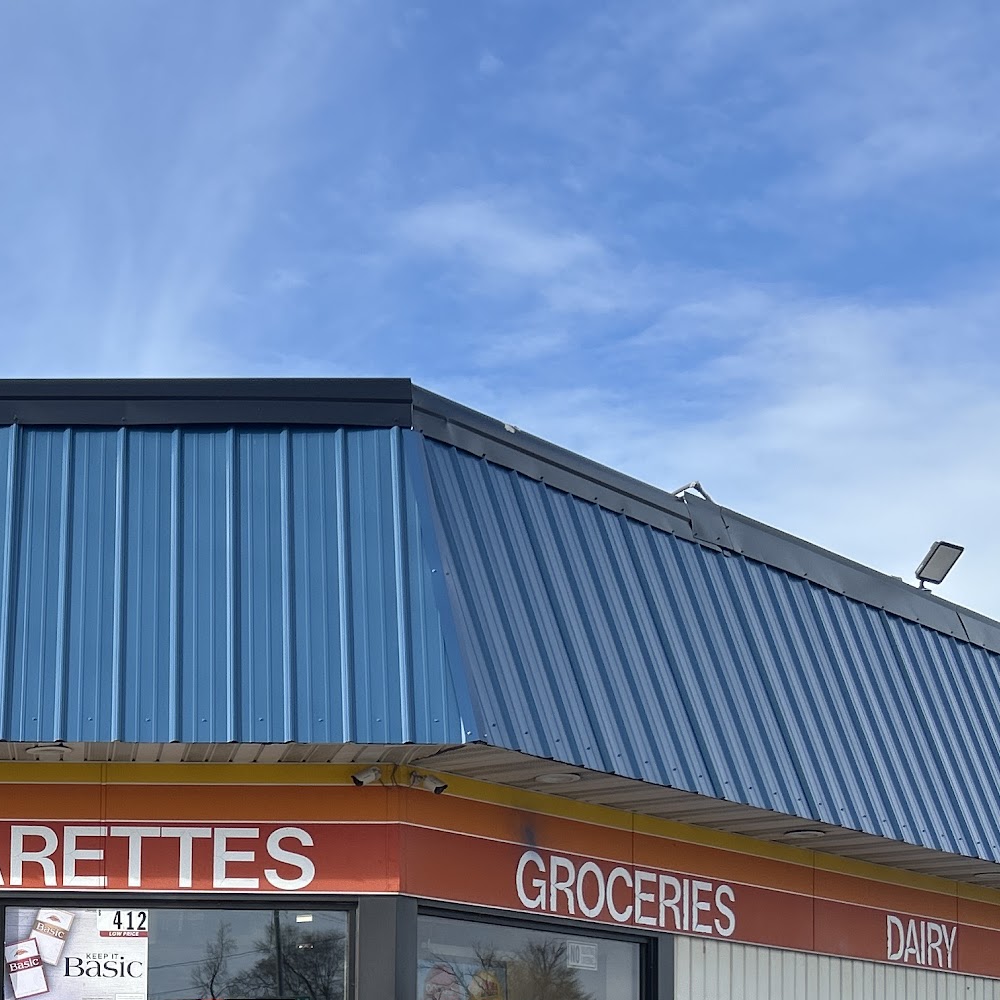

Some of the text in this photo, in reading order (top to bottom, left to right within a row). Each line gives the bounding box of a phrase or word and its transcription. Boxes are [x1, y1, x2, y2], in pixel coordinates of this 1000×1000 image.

[515, 850, 736, 937] GROCERIES
[36, 922, 65, 938] Basic
[886, 915, 957, 969] DAIRY
[570, 945, 579, 963] NO
[9, 958, 40, 972] Basic
[64, 957, 143, 978] Basic
